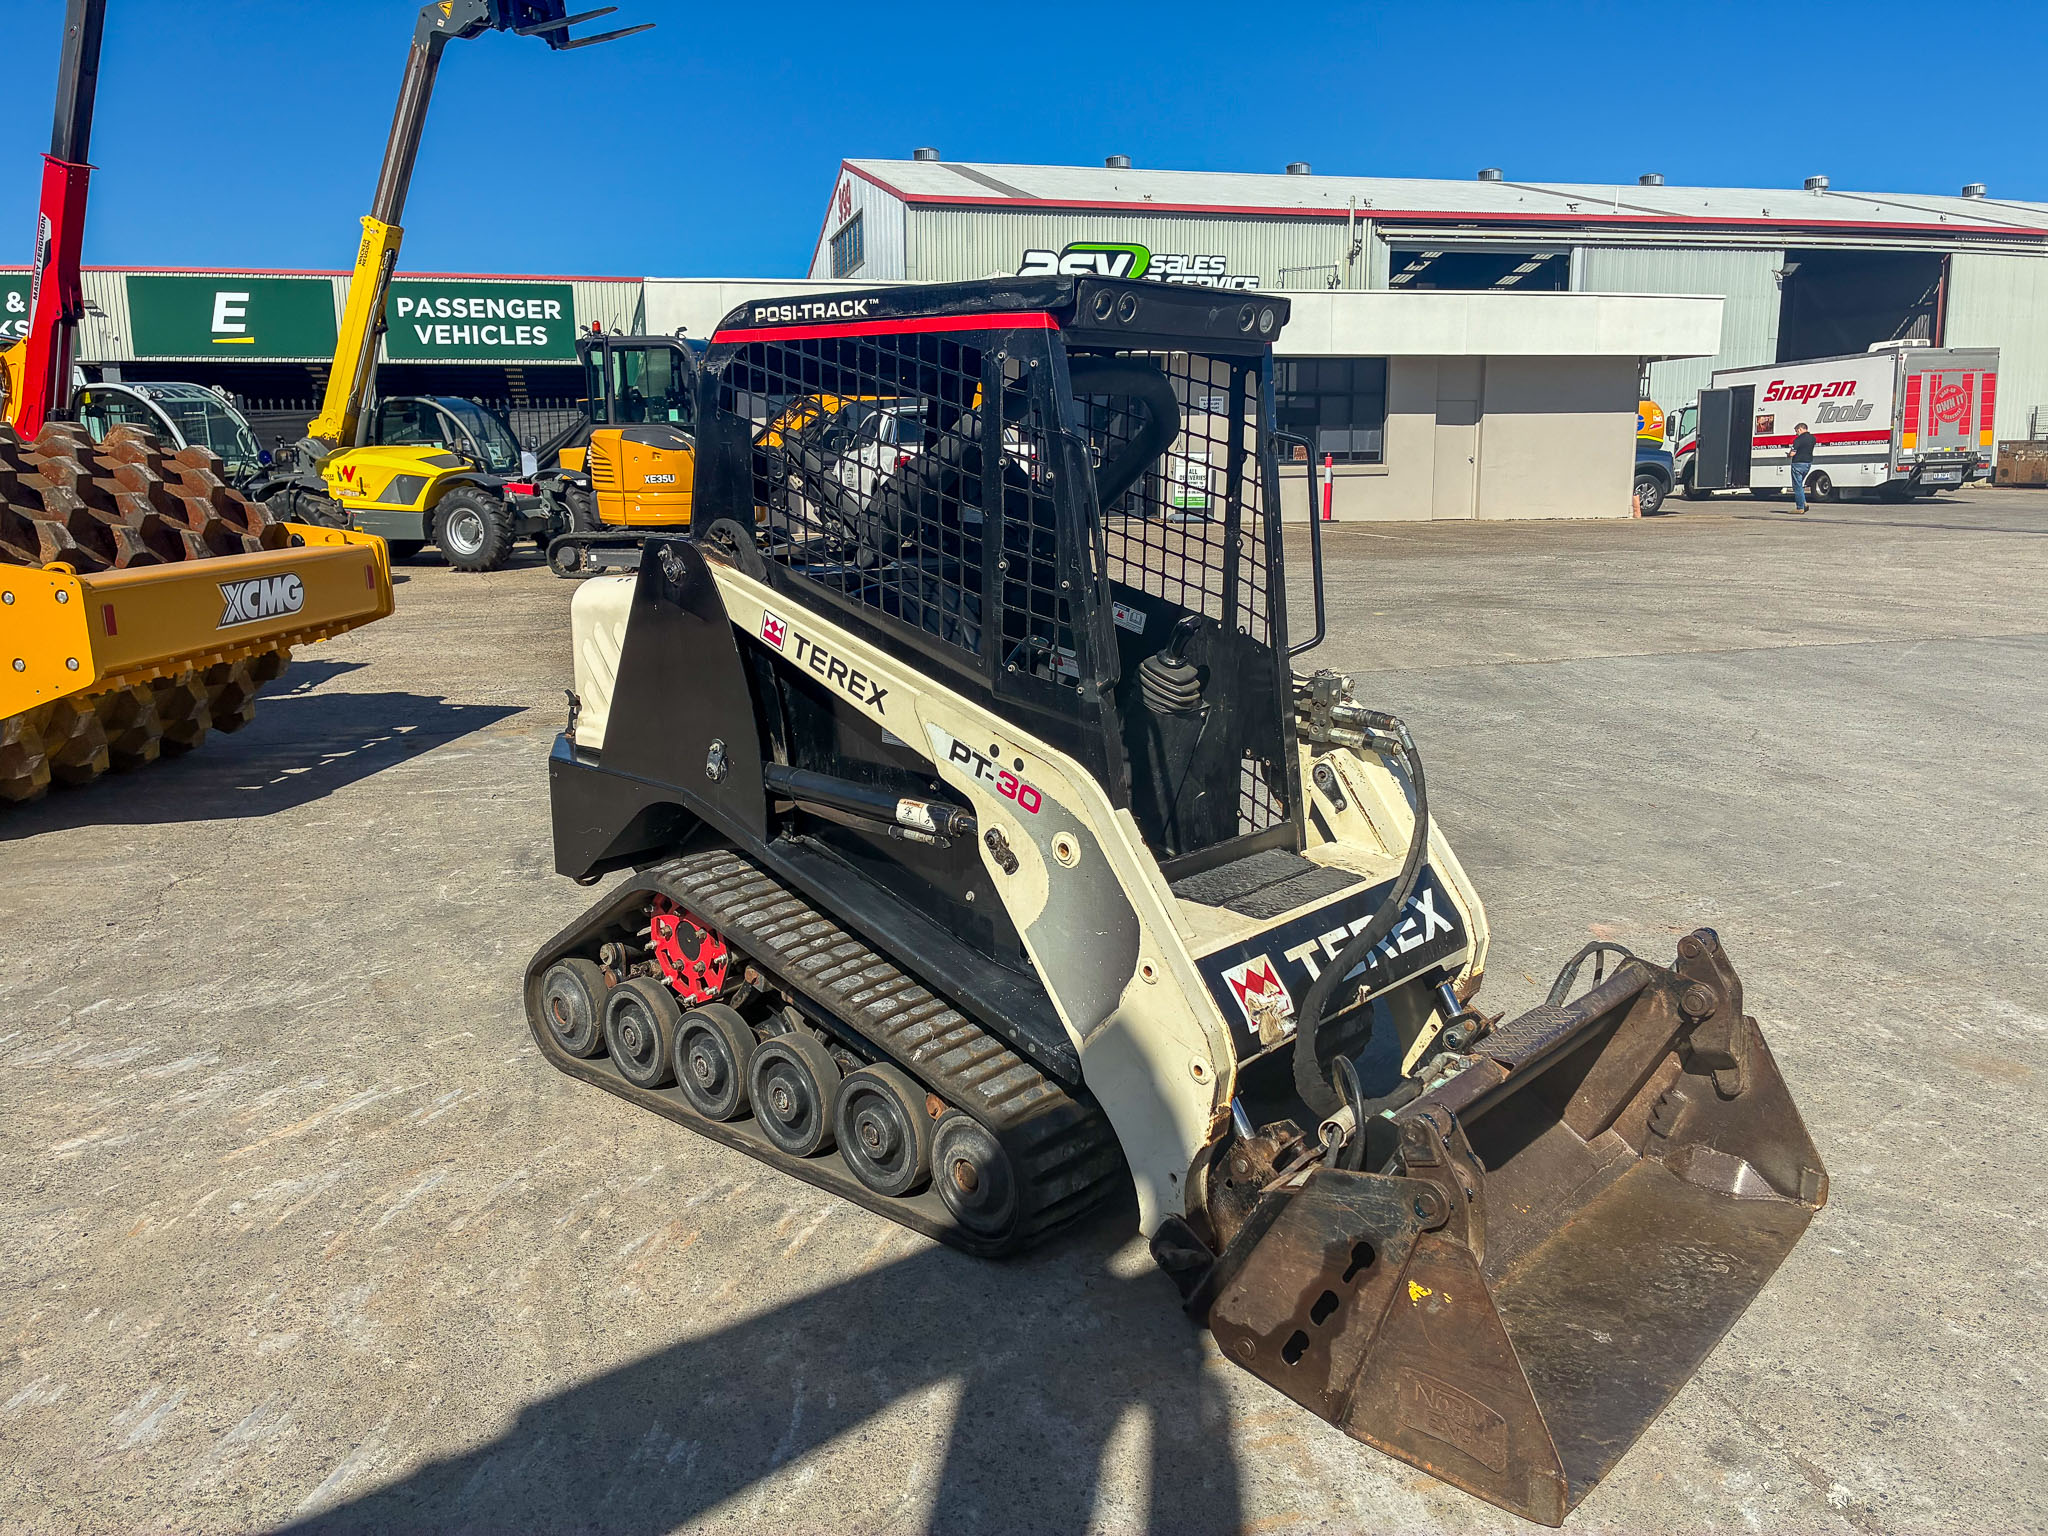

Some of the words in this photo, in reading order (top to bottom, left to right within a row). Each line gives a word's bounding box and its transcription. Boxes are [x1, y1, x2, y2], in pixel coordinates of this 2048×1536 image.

[37, 215, 47, 263] FERGUSON
[33, 265, 42, 301] MASSEY
[5, 291, 26, 313] &
[211, 291, 250, 333] E
[396, 297, 562, 320] PASSENGER
[413, 324, 548, 346] VEHICLES
[1763, 379, 1857, 405] Snap-on
[1936, 397, 1956, 413] OWN
[1956, 393, 1964, 405] IT
[1815, 399, 1874, 424] Tools
[644, 474, 676, 484] XE35U
[221, 574, 304, 624] XCMG
[793, 632, 889, 716] TEREX
[948, 738, 1042, 815] PT-30
